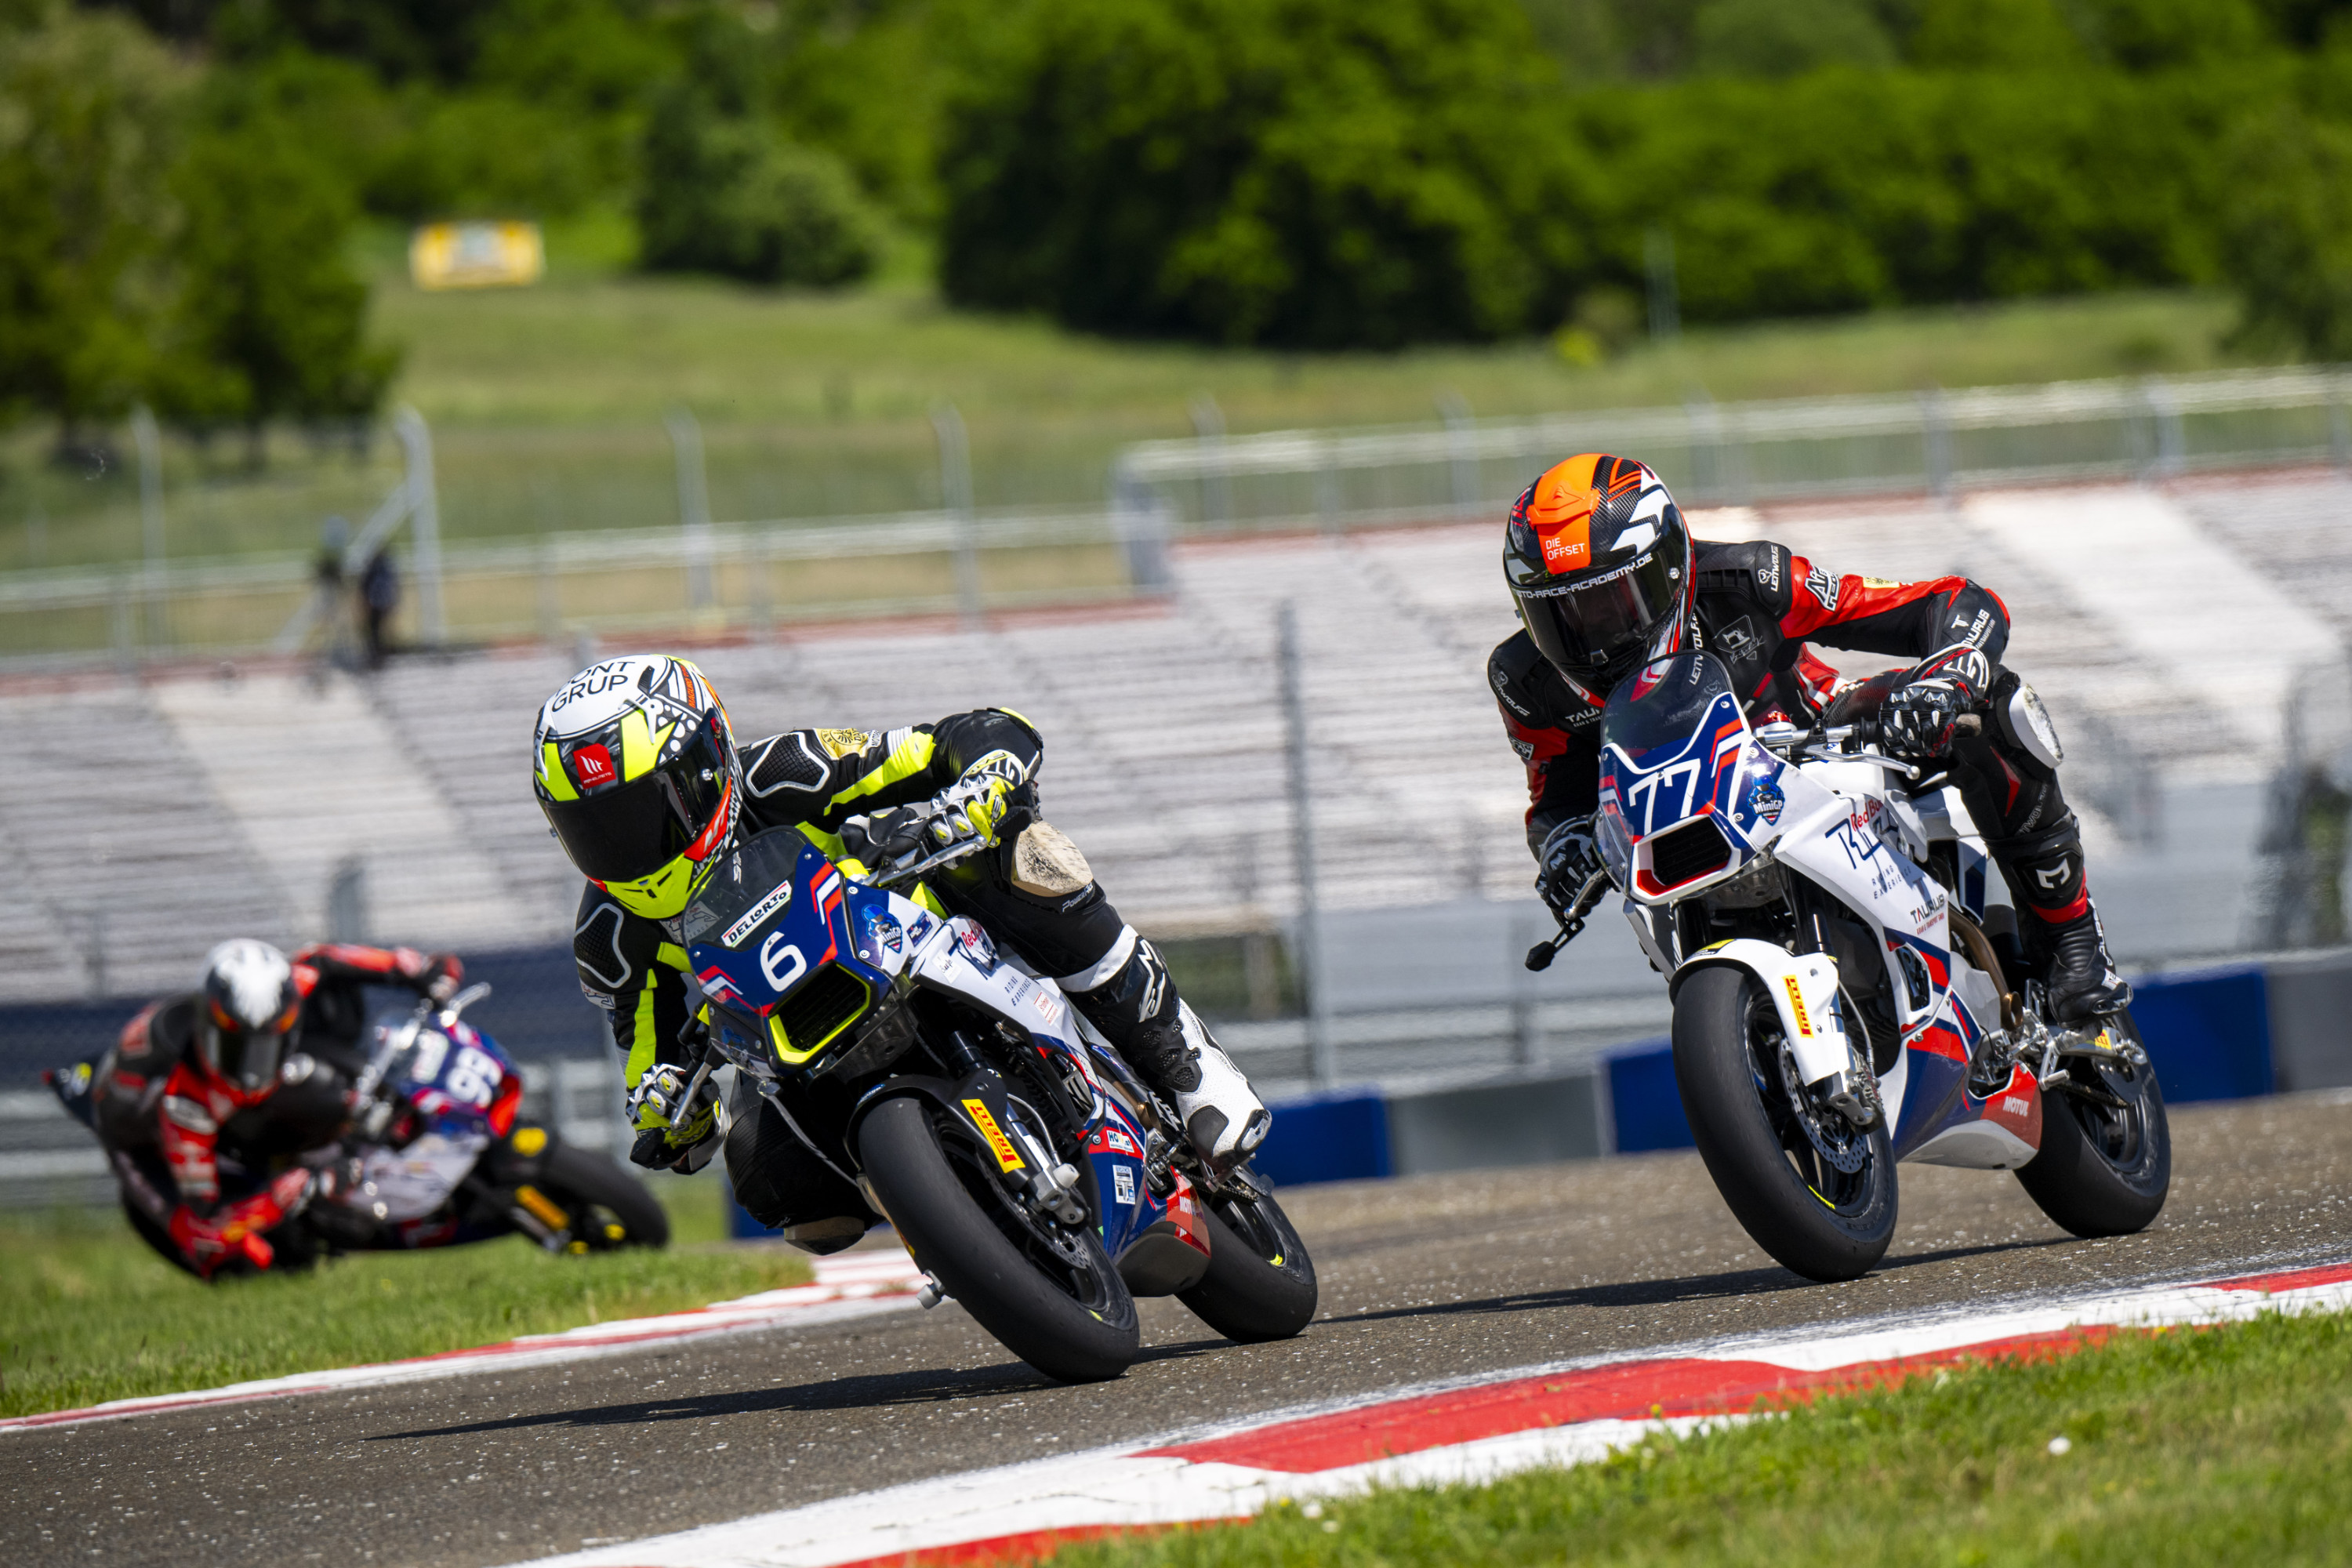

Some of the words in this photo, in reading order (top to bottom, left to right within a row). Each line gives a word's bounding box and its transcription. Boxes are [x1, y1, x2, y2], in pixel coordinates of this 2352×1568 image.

[1545, 538, 1561, 550] DIE
[1547, 543, 1585, 561] OFFSET
[551, 674, 629, 713] GRUP
[556, 662, 637, 697] ONT
[1628, 757, 1700, 836] 77
[1752, 799, 1783, 815] MiniGP
[1850, 801, 1868, 832] Red
[1910, 893, 1945, 924] TAURUS
[760, 931, 808, 993] 6
[1785, 978, 1811, 1036] PIRELLI
[2003, 1096, 2030, 1117] MOTUL
[969, 1105, 1018, 1163] PIRELLI
